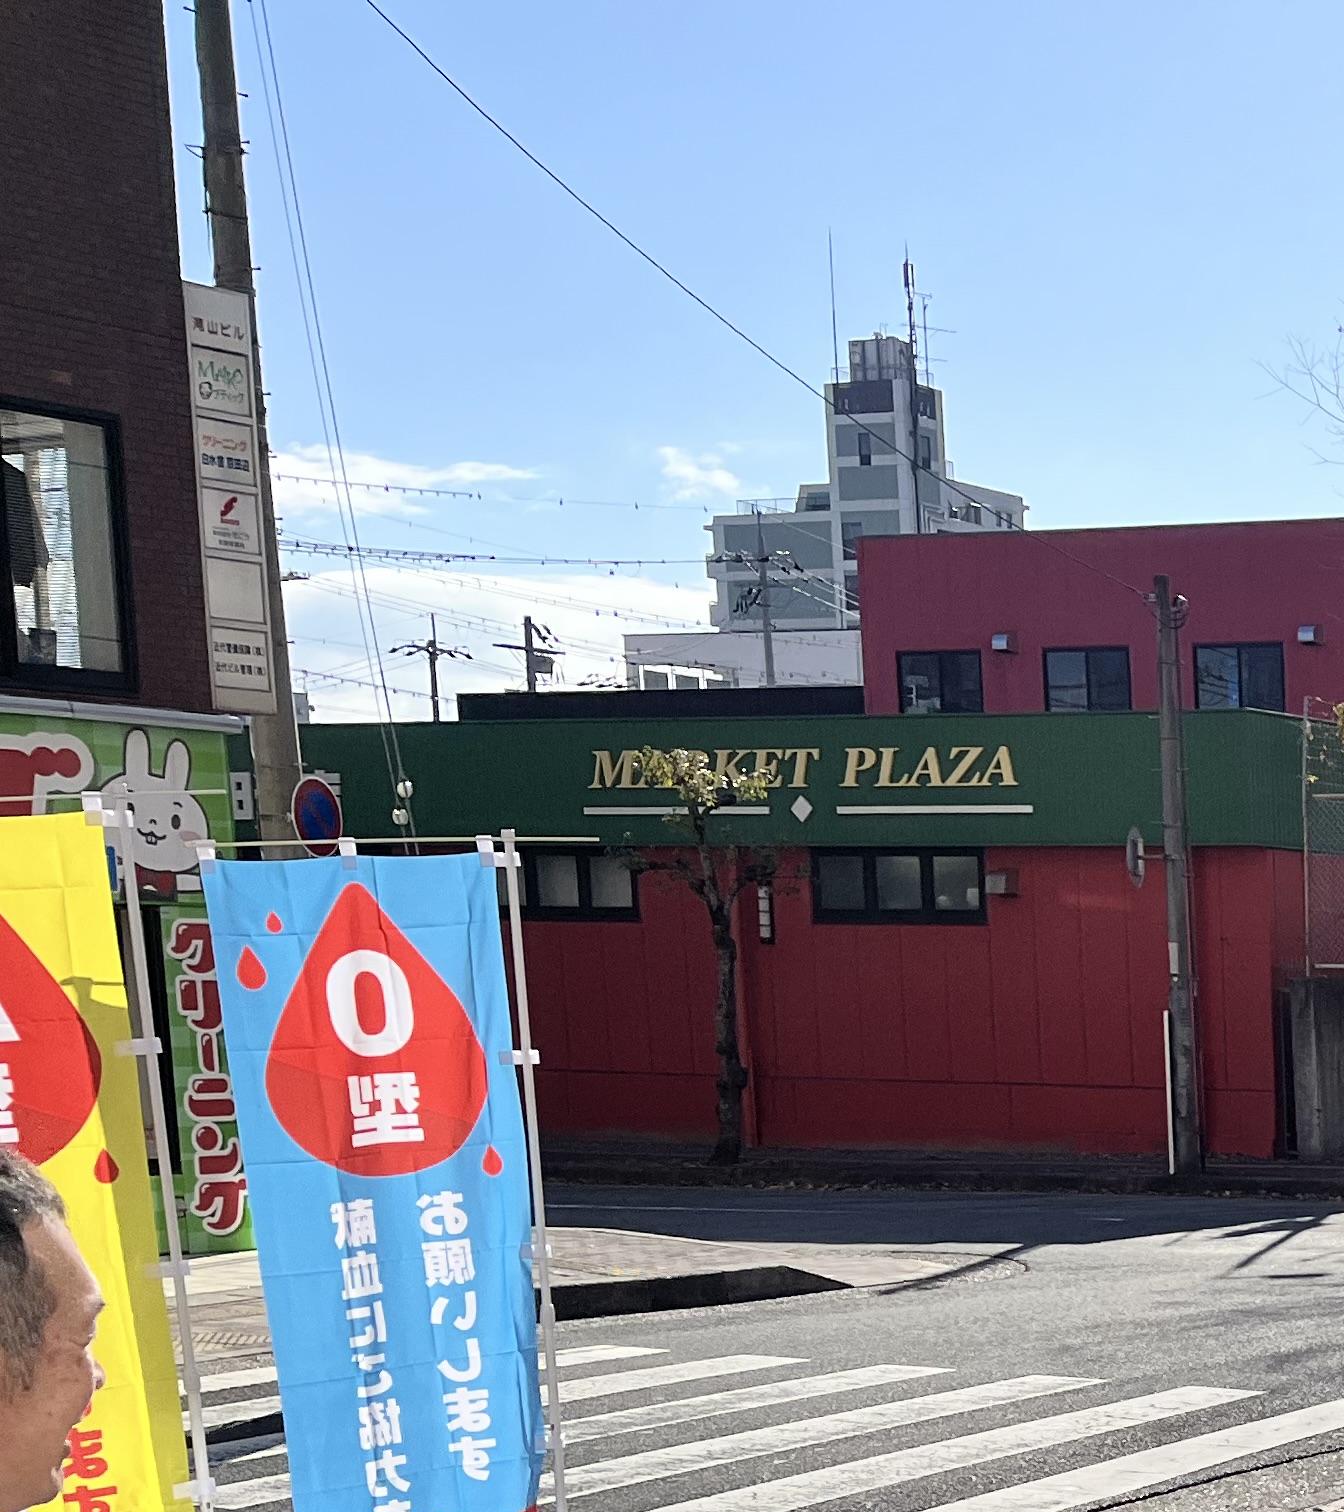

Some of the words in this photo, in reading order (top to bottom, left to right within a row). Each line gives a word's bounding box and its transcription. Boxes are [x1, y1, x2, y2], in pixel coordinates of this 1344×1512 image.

[588, 748, 820, 790] MKET
[838, 745, 1019, 788] PLAZA
[168, 919, 247, 1235] クリーニング
